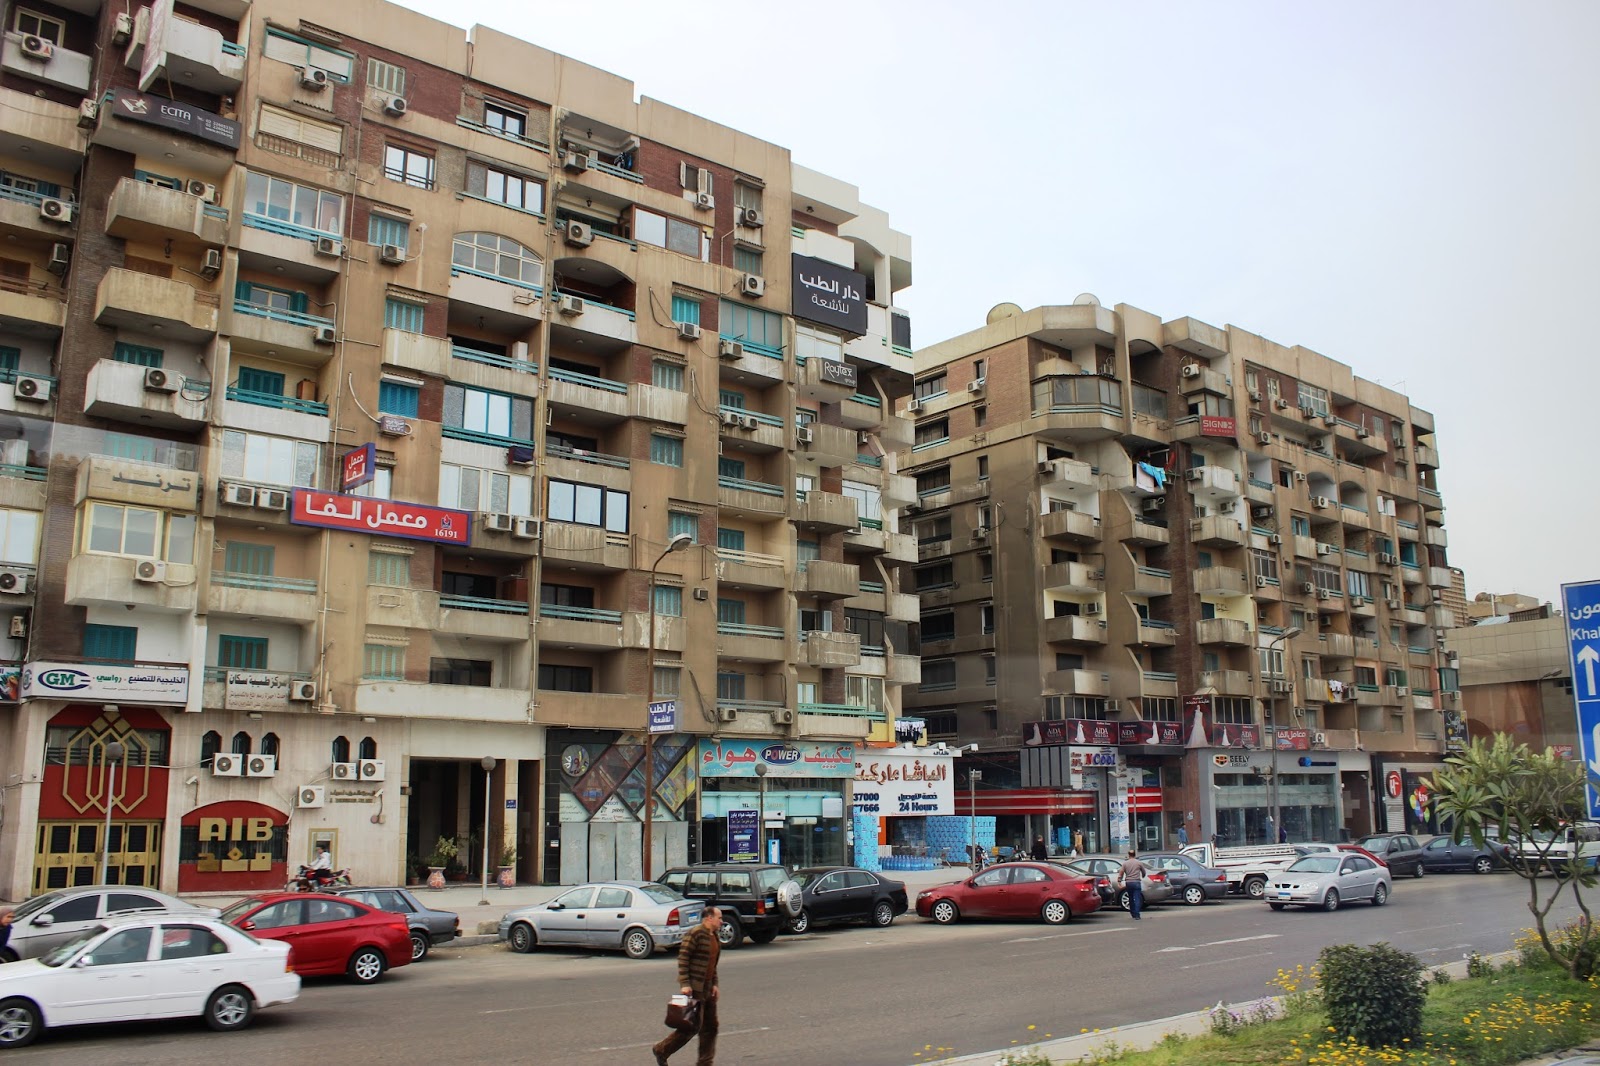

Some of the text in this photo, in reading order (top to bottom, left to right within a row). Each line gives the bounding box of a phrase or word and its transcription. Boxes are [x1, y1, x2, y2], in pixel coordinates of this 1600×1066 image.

[160, 105, 191, 120] ECITA
[799, 273, 860, 301] دار الطب
[811, 293, 850, 314] للأشعة
[348, 454, 364, 470] معمل
[305, 494, 428, 529] معمل الفا
[434, 528, 458, 539] 16191
[45, 672, 76, 687] GM
[650, 703, 675, 715] دار الطب
[703, 745, 757, 768] هواء
[765, 749, 798, 761] POWER
[804, 746, 853, 769] تكييف
[902, 760, 947, 788] الباشا
[853, 804, 880, 812] 7666
[899, 802, 939, 812] 24 Hours
[198, 817, 275, 841] AIB
